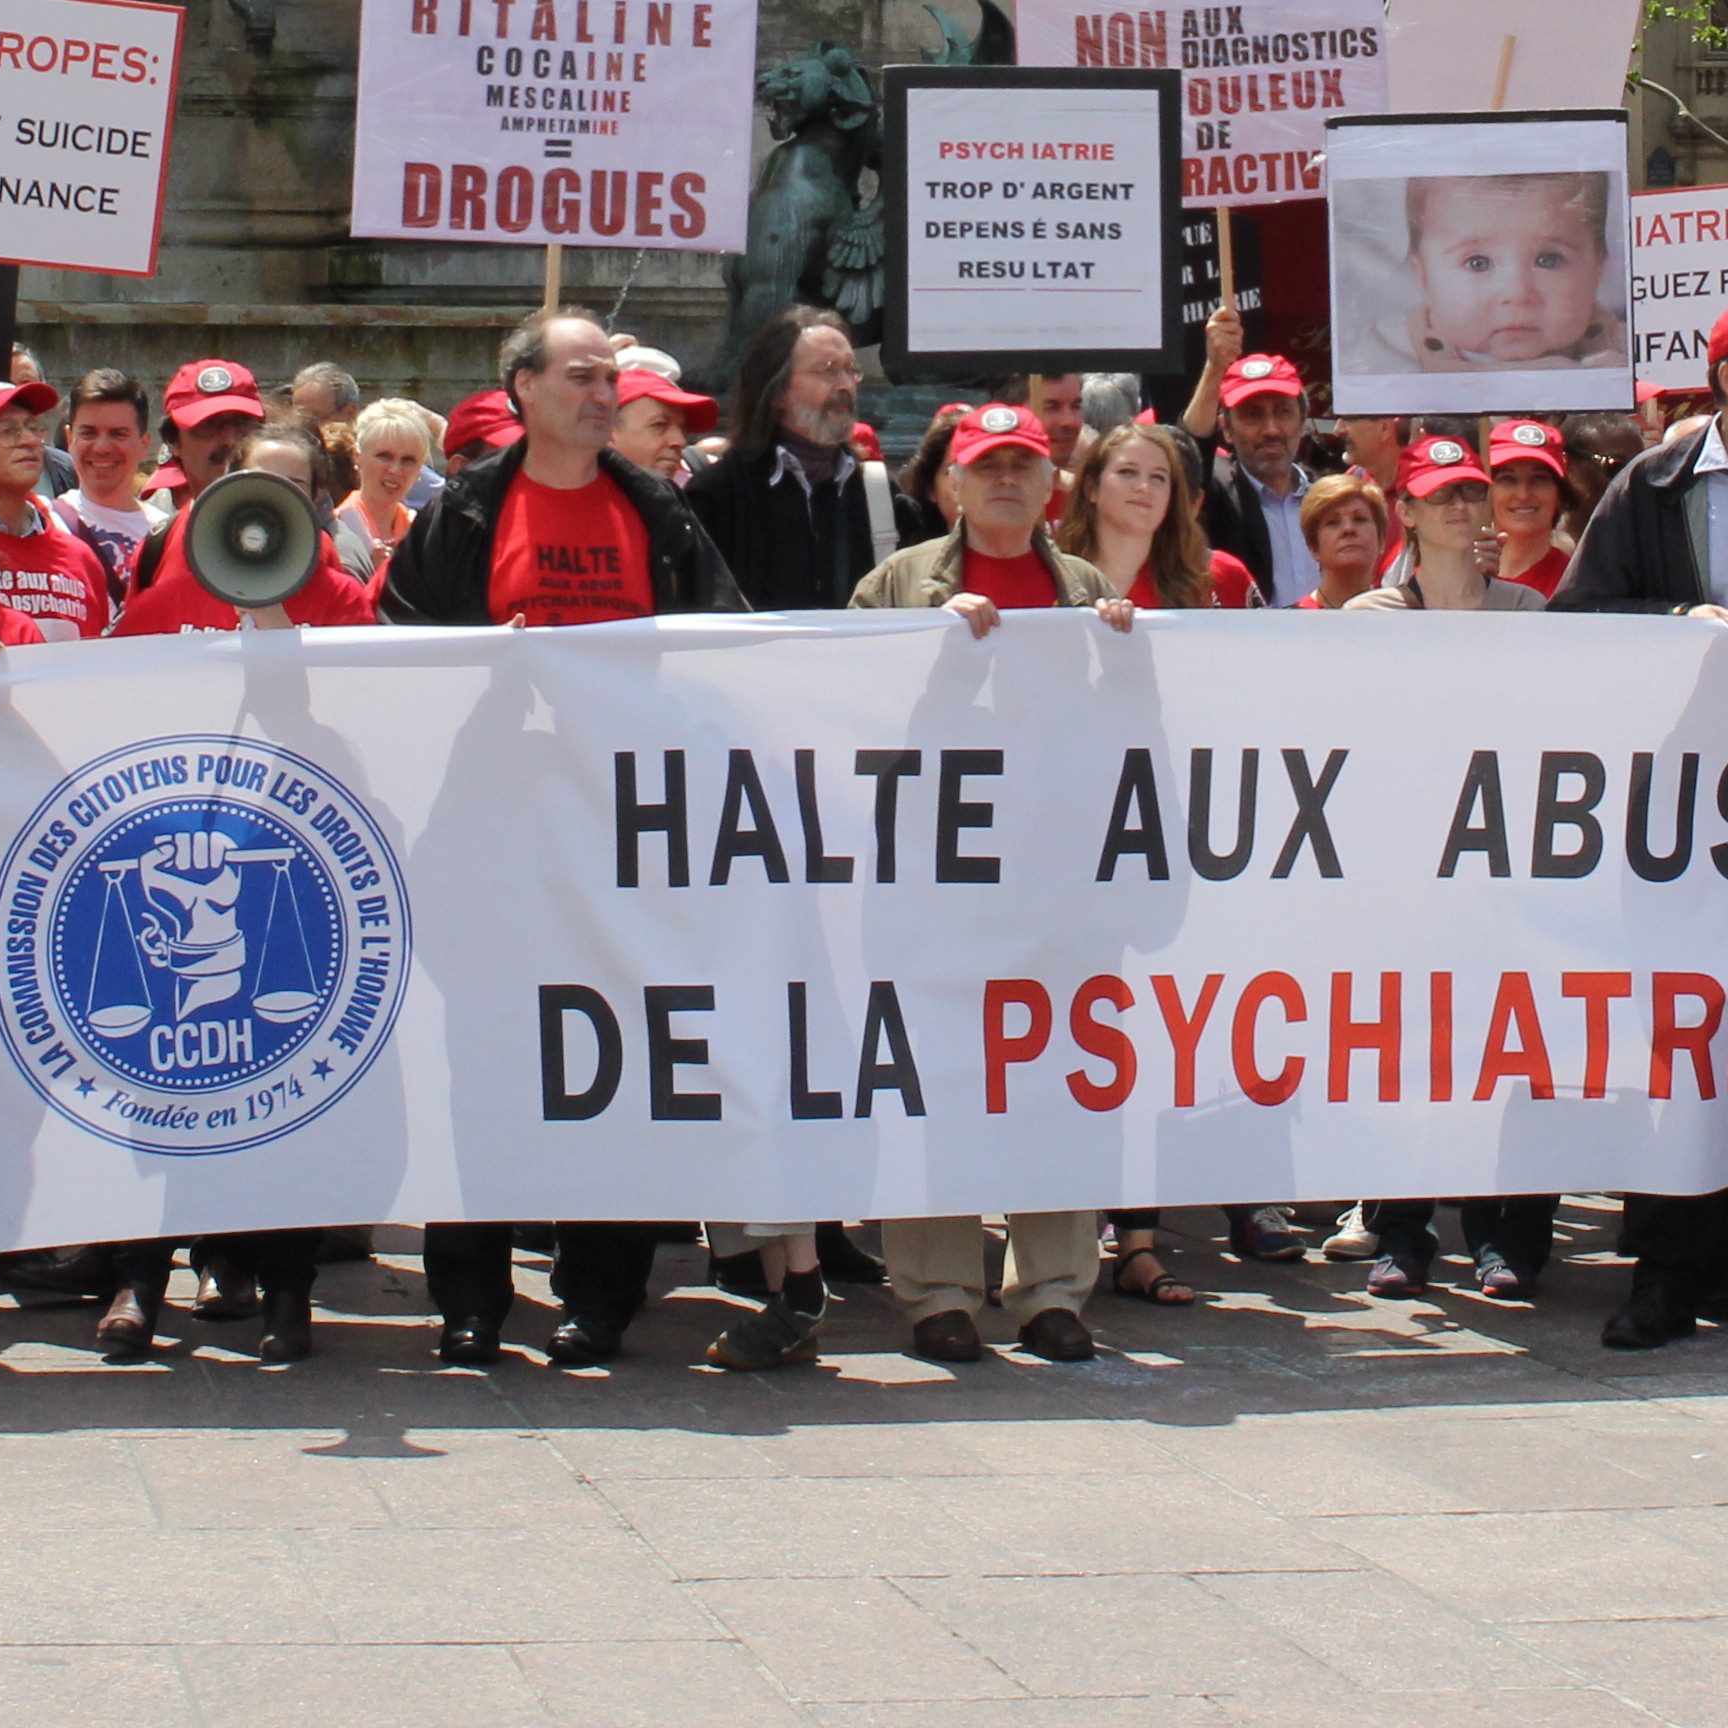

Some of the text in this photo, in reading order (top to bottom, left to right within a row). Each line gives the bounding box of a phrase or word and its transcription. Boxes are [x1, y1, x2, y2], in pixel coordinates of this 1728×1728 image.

[1075, 10, 1169, 68] NON
[1181, 6, 1244, 38] AUX
[476, 45, 647, 83] COCAINE
[1181, 27, 1378, 69] DIAGNOSTICS
[486, 84, 632, 113] MESCALINE
[15, 117, 152, 159] SUICIDE
[500, 115, 619, 136] AMPHETAMINE
[1196, 121, 1232, 152] DE
[401, 161, 707, 239] DROGUES
[925, 182, 992, 199] TROP
[1055, 222, 1122, 240] SANS
[537, 545, 622, 574] HALTE
[615, 748, 1006, 889] HALTE
[1096, 746, 1351, 883] AUX
[6, 754, 392, 1079] LA COMMISSION DES CITOYENS POUR LES DROITS DE L'HOMME
[149, 1017, 255, 1073] CCDH
[537, 982, 722, 1122] DE
[787, 979, 927, 1120] LA
[101, 1072, 306, 1129] Fondée en 1974
